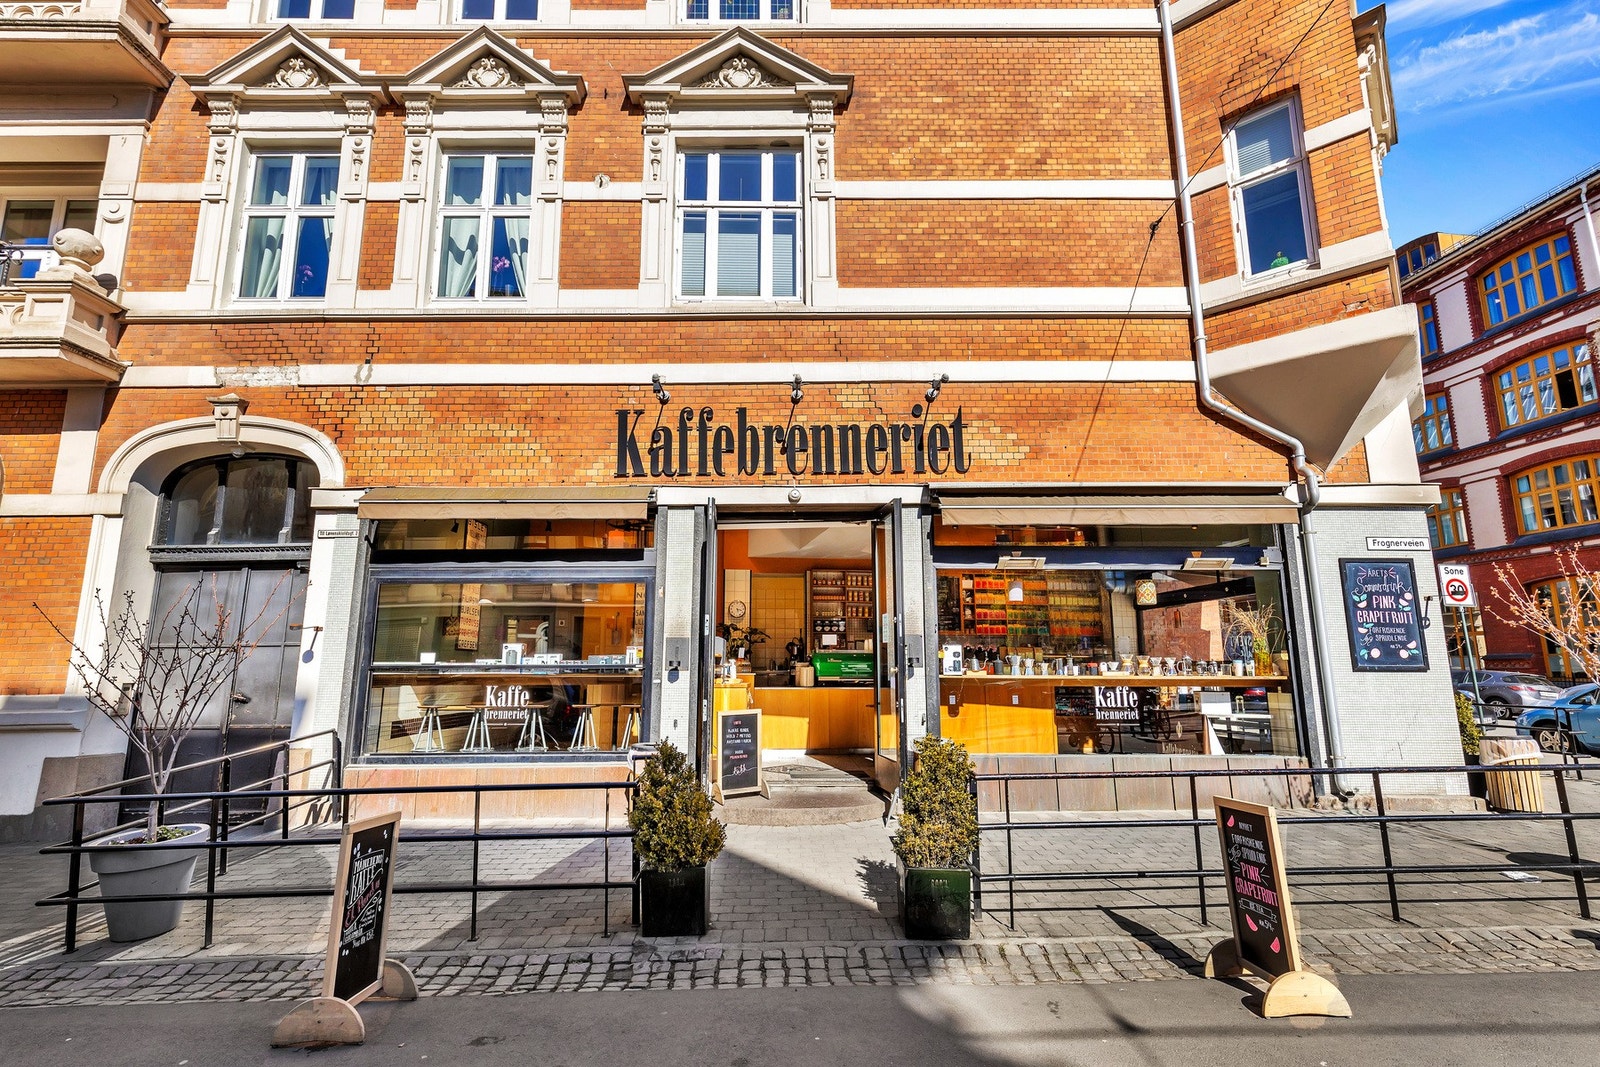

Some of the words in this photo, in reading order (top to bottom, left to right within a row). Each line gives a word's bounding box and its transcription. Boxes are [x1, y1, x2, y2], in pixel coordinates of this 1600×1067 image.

[613, 404, 972, 478] Kaffebrenneriet
[1372, 539, 1425, 548] Frognerveien
[1367, 568, 1389, 577] ÅRETS
[1444, 567, 1464, 575] Sone
[1372, 595, 1396, 609] PINK
[1357, 610, 1414, 625] GRAPEFRUIT
[485, 684, 530, 708] Kaffe
[1094, 686, 1139, 708] Kaffe
[484, 708, 529, 720] brenneriet
[1095, 708, 1140, 720] brenneriet
[1240, 861, 1262, 883] PINK
[349, 865, 377, 905] KAFFE
[1234, 876, 1279, 907] GRAPEFRUIT
